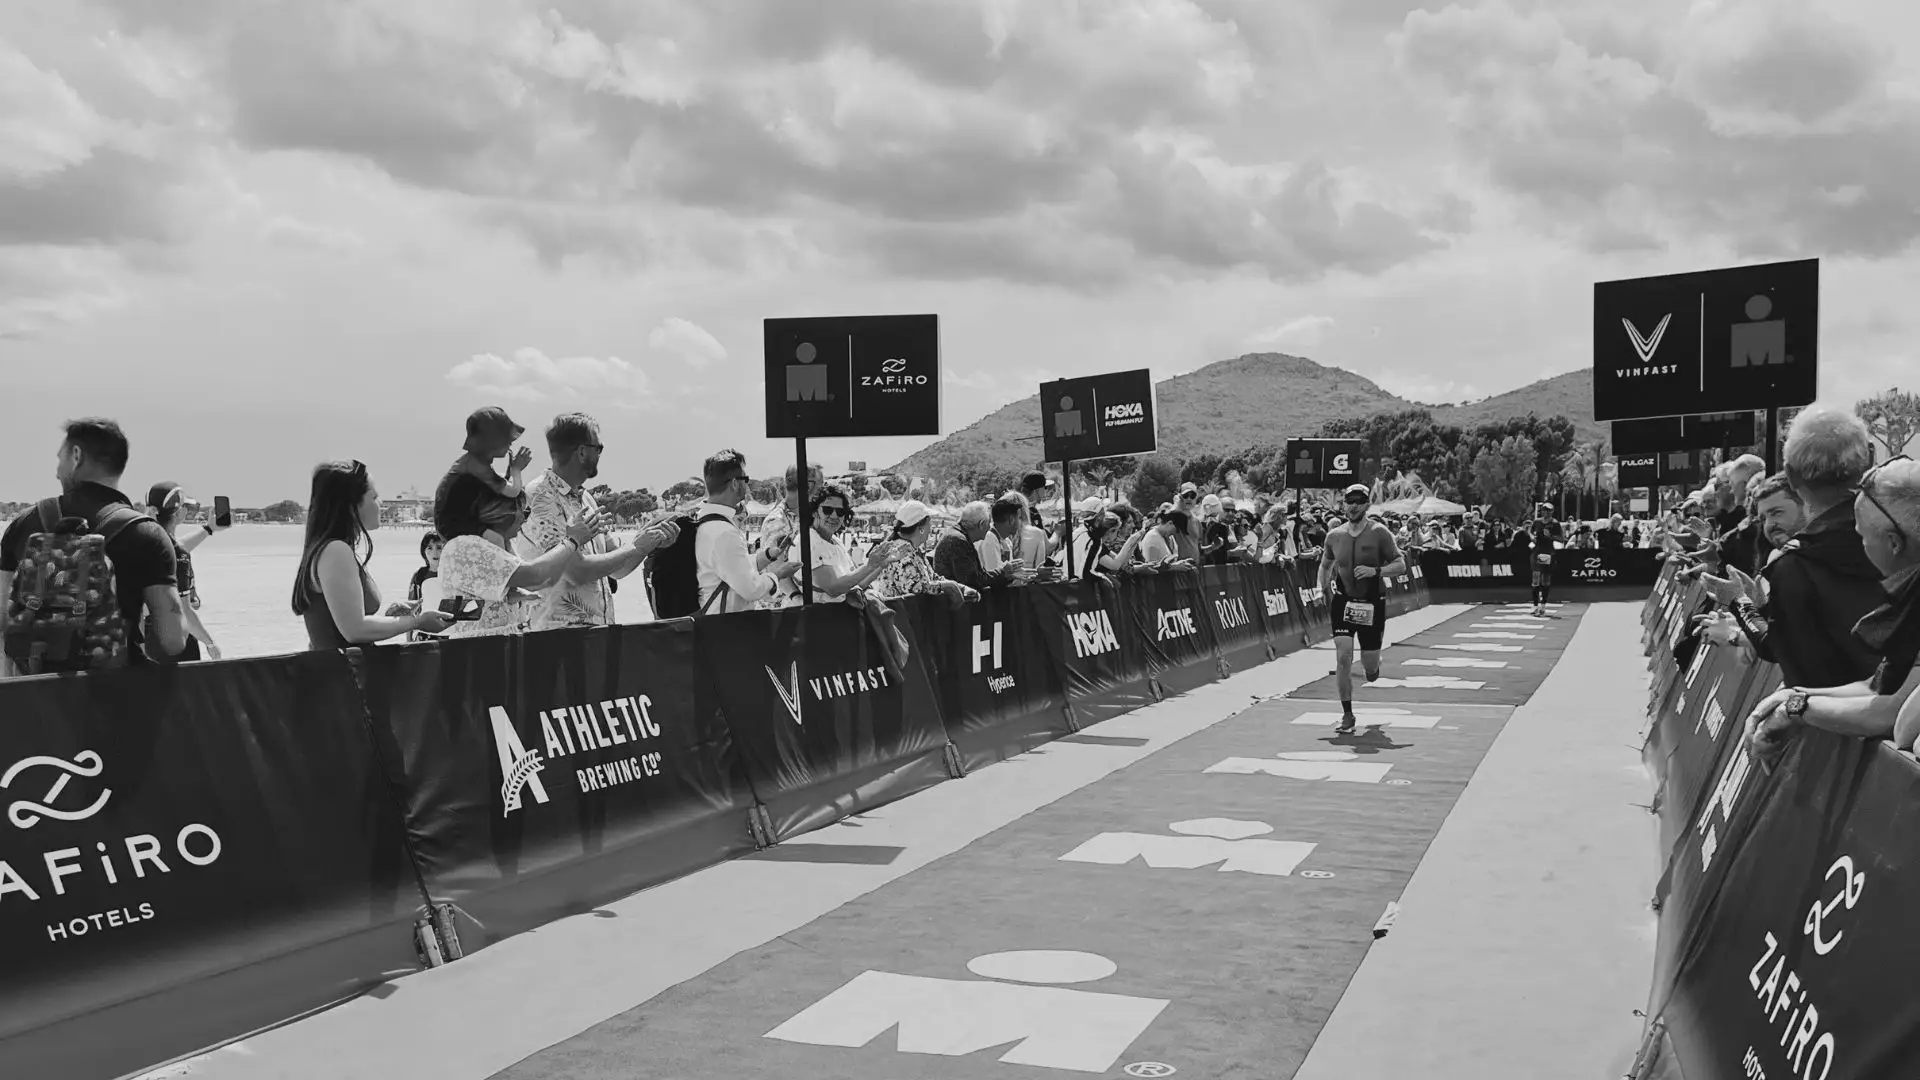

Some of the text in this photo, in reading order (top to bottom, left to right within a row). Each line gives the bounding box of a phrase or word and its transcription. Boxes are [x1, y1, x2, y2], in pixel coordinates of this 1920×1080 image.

[1616, 364, 1678, 378] VINFAST
[1105, 402, 1144, 420] HOKA
[1067, 610, 1120, 658] HOKA
[1157, 607, 1197, 642] ACTIVE
[809, 666, 888, 701] VINFAST
[539, 694, 661, 759] ATHLETIC
[576, 757, 641, 793] BREWING
[47, 902, 155, 942] HOTELS
